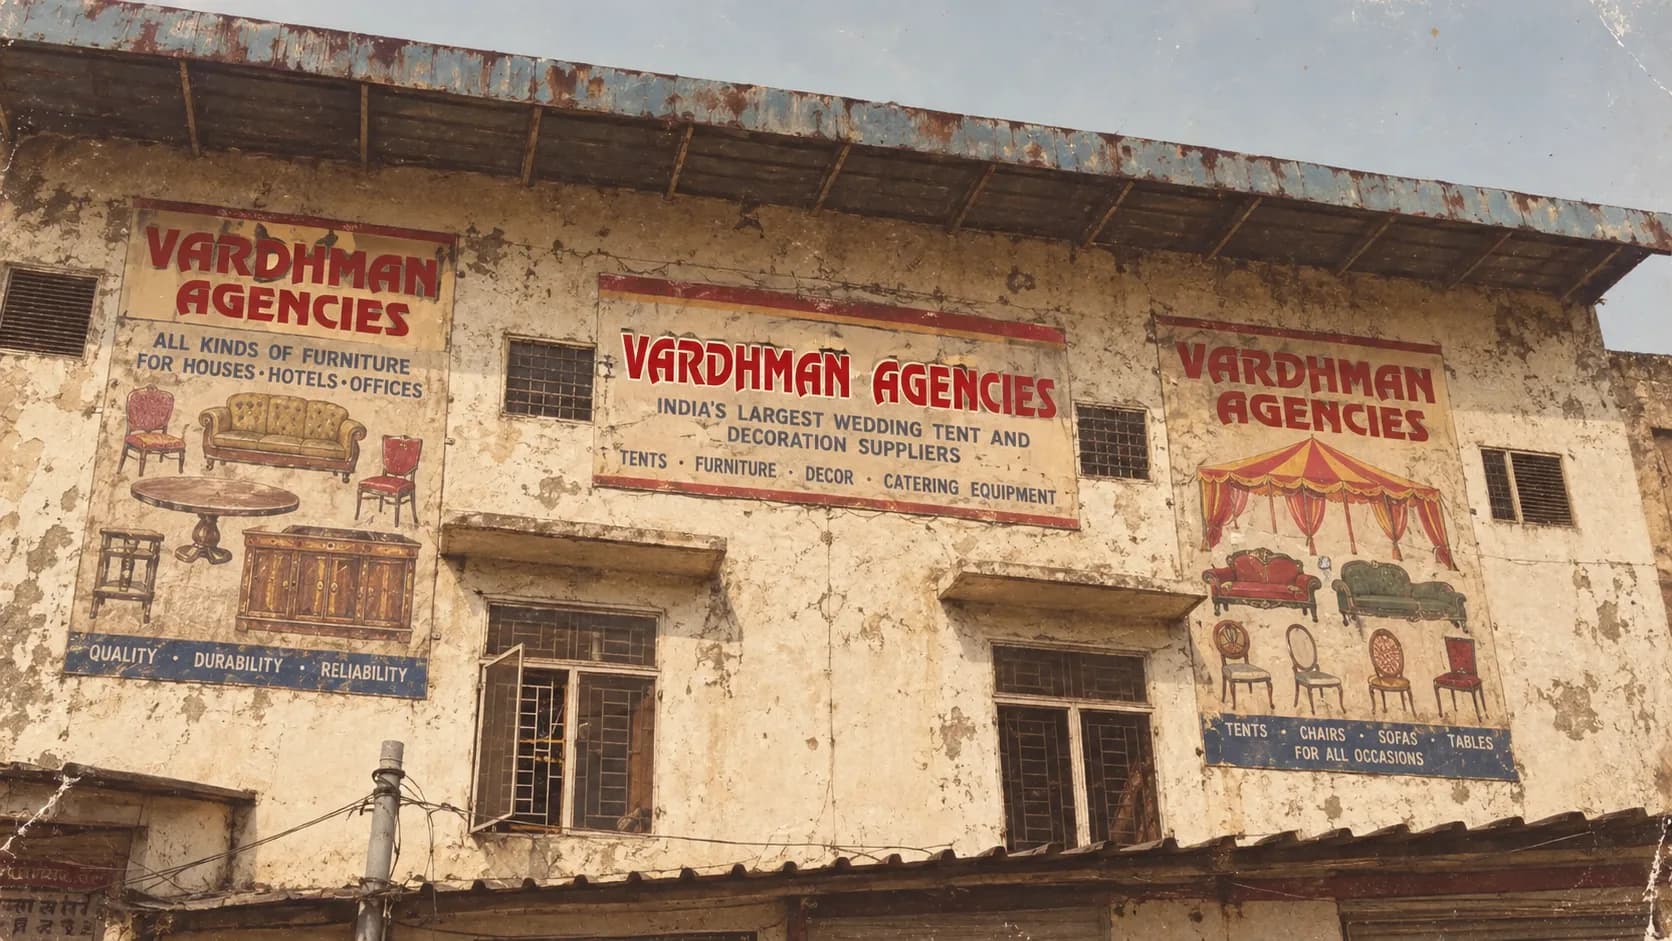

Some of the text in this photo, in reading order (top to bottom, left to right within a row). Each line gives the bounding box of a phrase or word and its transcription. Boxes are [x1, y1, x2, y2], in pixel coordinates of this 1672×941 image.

[146, 226, 437, 299] VARDHMAN
[176, 280, 410, 337] AGENCIES
[136, 353, 423, 398] FOR HOUSES HOTELS OFFICES
[153, 332, 410, 375] ALL KINDS OF FURNITURE
[621, 332, 1057, 418] VARDHMAN AGENCIES
[1175, 341, 1436, 404] VARDHMAN
[657, 398, 1030, 448] INDIA'S LARGEST WEDDING TENT AND
[1216, 390, 1429, 442] AGENCIES
[728, 426, 961, 463] DECORATION SUPPLIERS
[620, 450, 1056, 505] TENTS FURNITURE DECOR CATERING EQUIPMENT
[90, 644, 407, 683] QUALITY DURABILITY RELIABILITY
[1225, 722, 1494, 750] TENTS CHAIRS SOFAS TABLES
[1295, 745, 1424, 766] FOR ALL OCCASIONS
